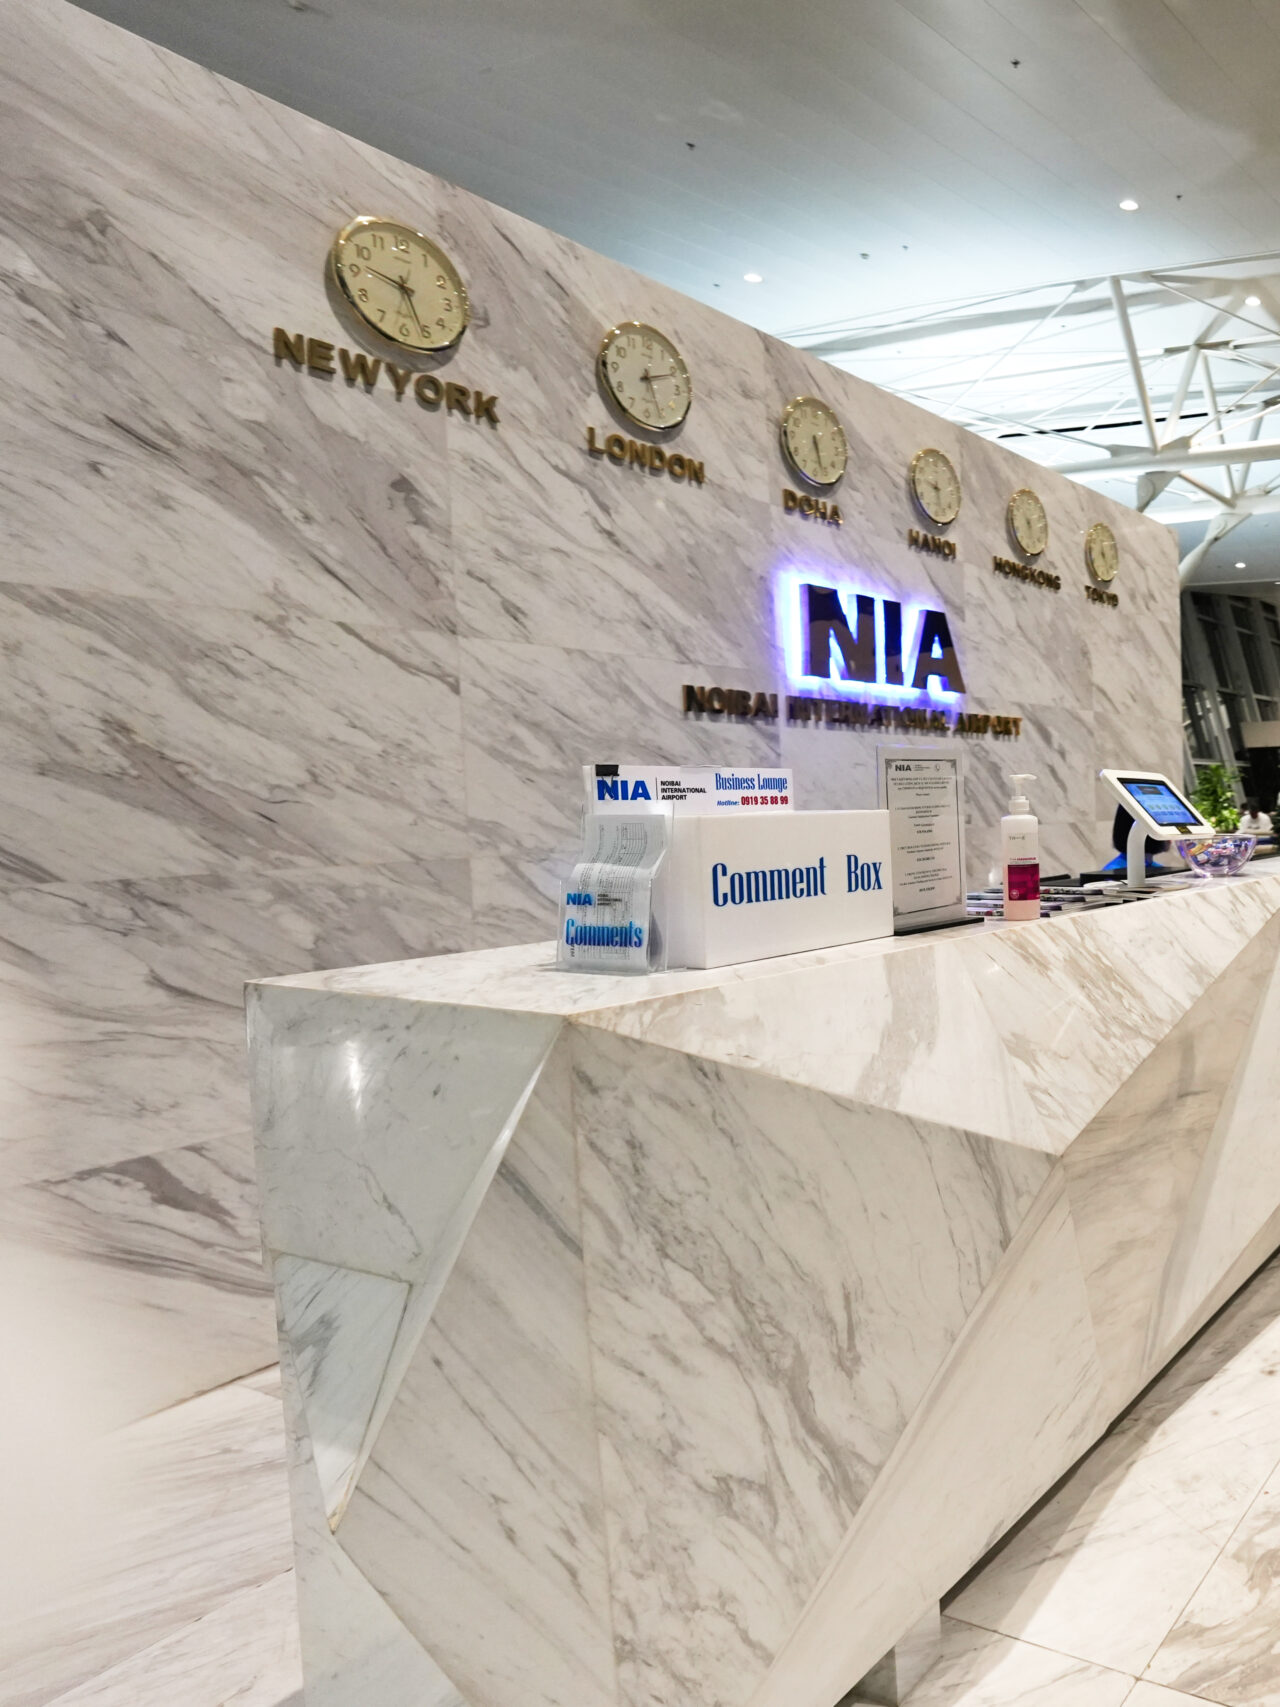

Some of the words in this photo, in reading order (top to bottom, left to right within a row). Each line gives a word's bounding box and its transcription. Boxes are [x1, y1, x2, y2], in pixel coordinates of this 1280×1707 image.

[372, 234, 385, 250] 11
[394, 235, 410, 254] 12
[354, 244, 372, 261] 10
[422, 254, 428, 268] 1
[349, 263, 361, 278] 9
[436, 275, 446, 289] 2
[358, 288, 368, 303] 8
[444, 298, 452, 312] 3
[377, 309, 386, 322] 7
[435, 318, 445, 330] 4
[399, 323, 410, 337] 6
[422, 325, 431, 339] 5
[273, 327, 500, 423] NEWYORK
[586, 426, 705, 485] LONDON
[782, 489, 843, 525] DOHA
[908, 529, 957, 559] HANOI
[993, 556, 1061, 590] HONGKONG
[1085, 585, 1119, 608] TOKYO
[799, 584, 966, 694] NIA
[682, 684, 778, 718] NOIBAI
[786, 695, 950, 732] INTERNATIONAL
[954, 712, 1023, 737] AIRPORT
[895, 764, 912, 772] NIA
[597, 779, 652, 800] NIA
[715, 773, 755, 790] Business
[757, 773, 788, 793] Lounge
[741, 796, 758, 805] 0919
[760, 796, 768, 805] 35
[770, 796, 778, 805] 88
[780, 795, 788, 805] 99
[712, 856, 827, 907] Comment
[846, 854, 883, 893] Box
[566, 893, 592, 906] NIA
[566, 918, 643, 948] Comments
